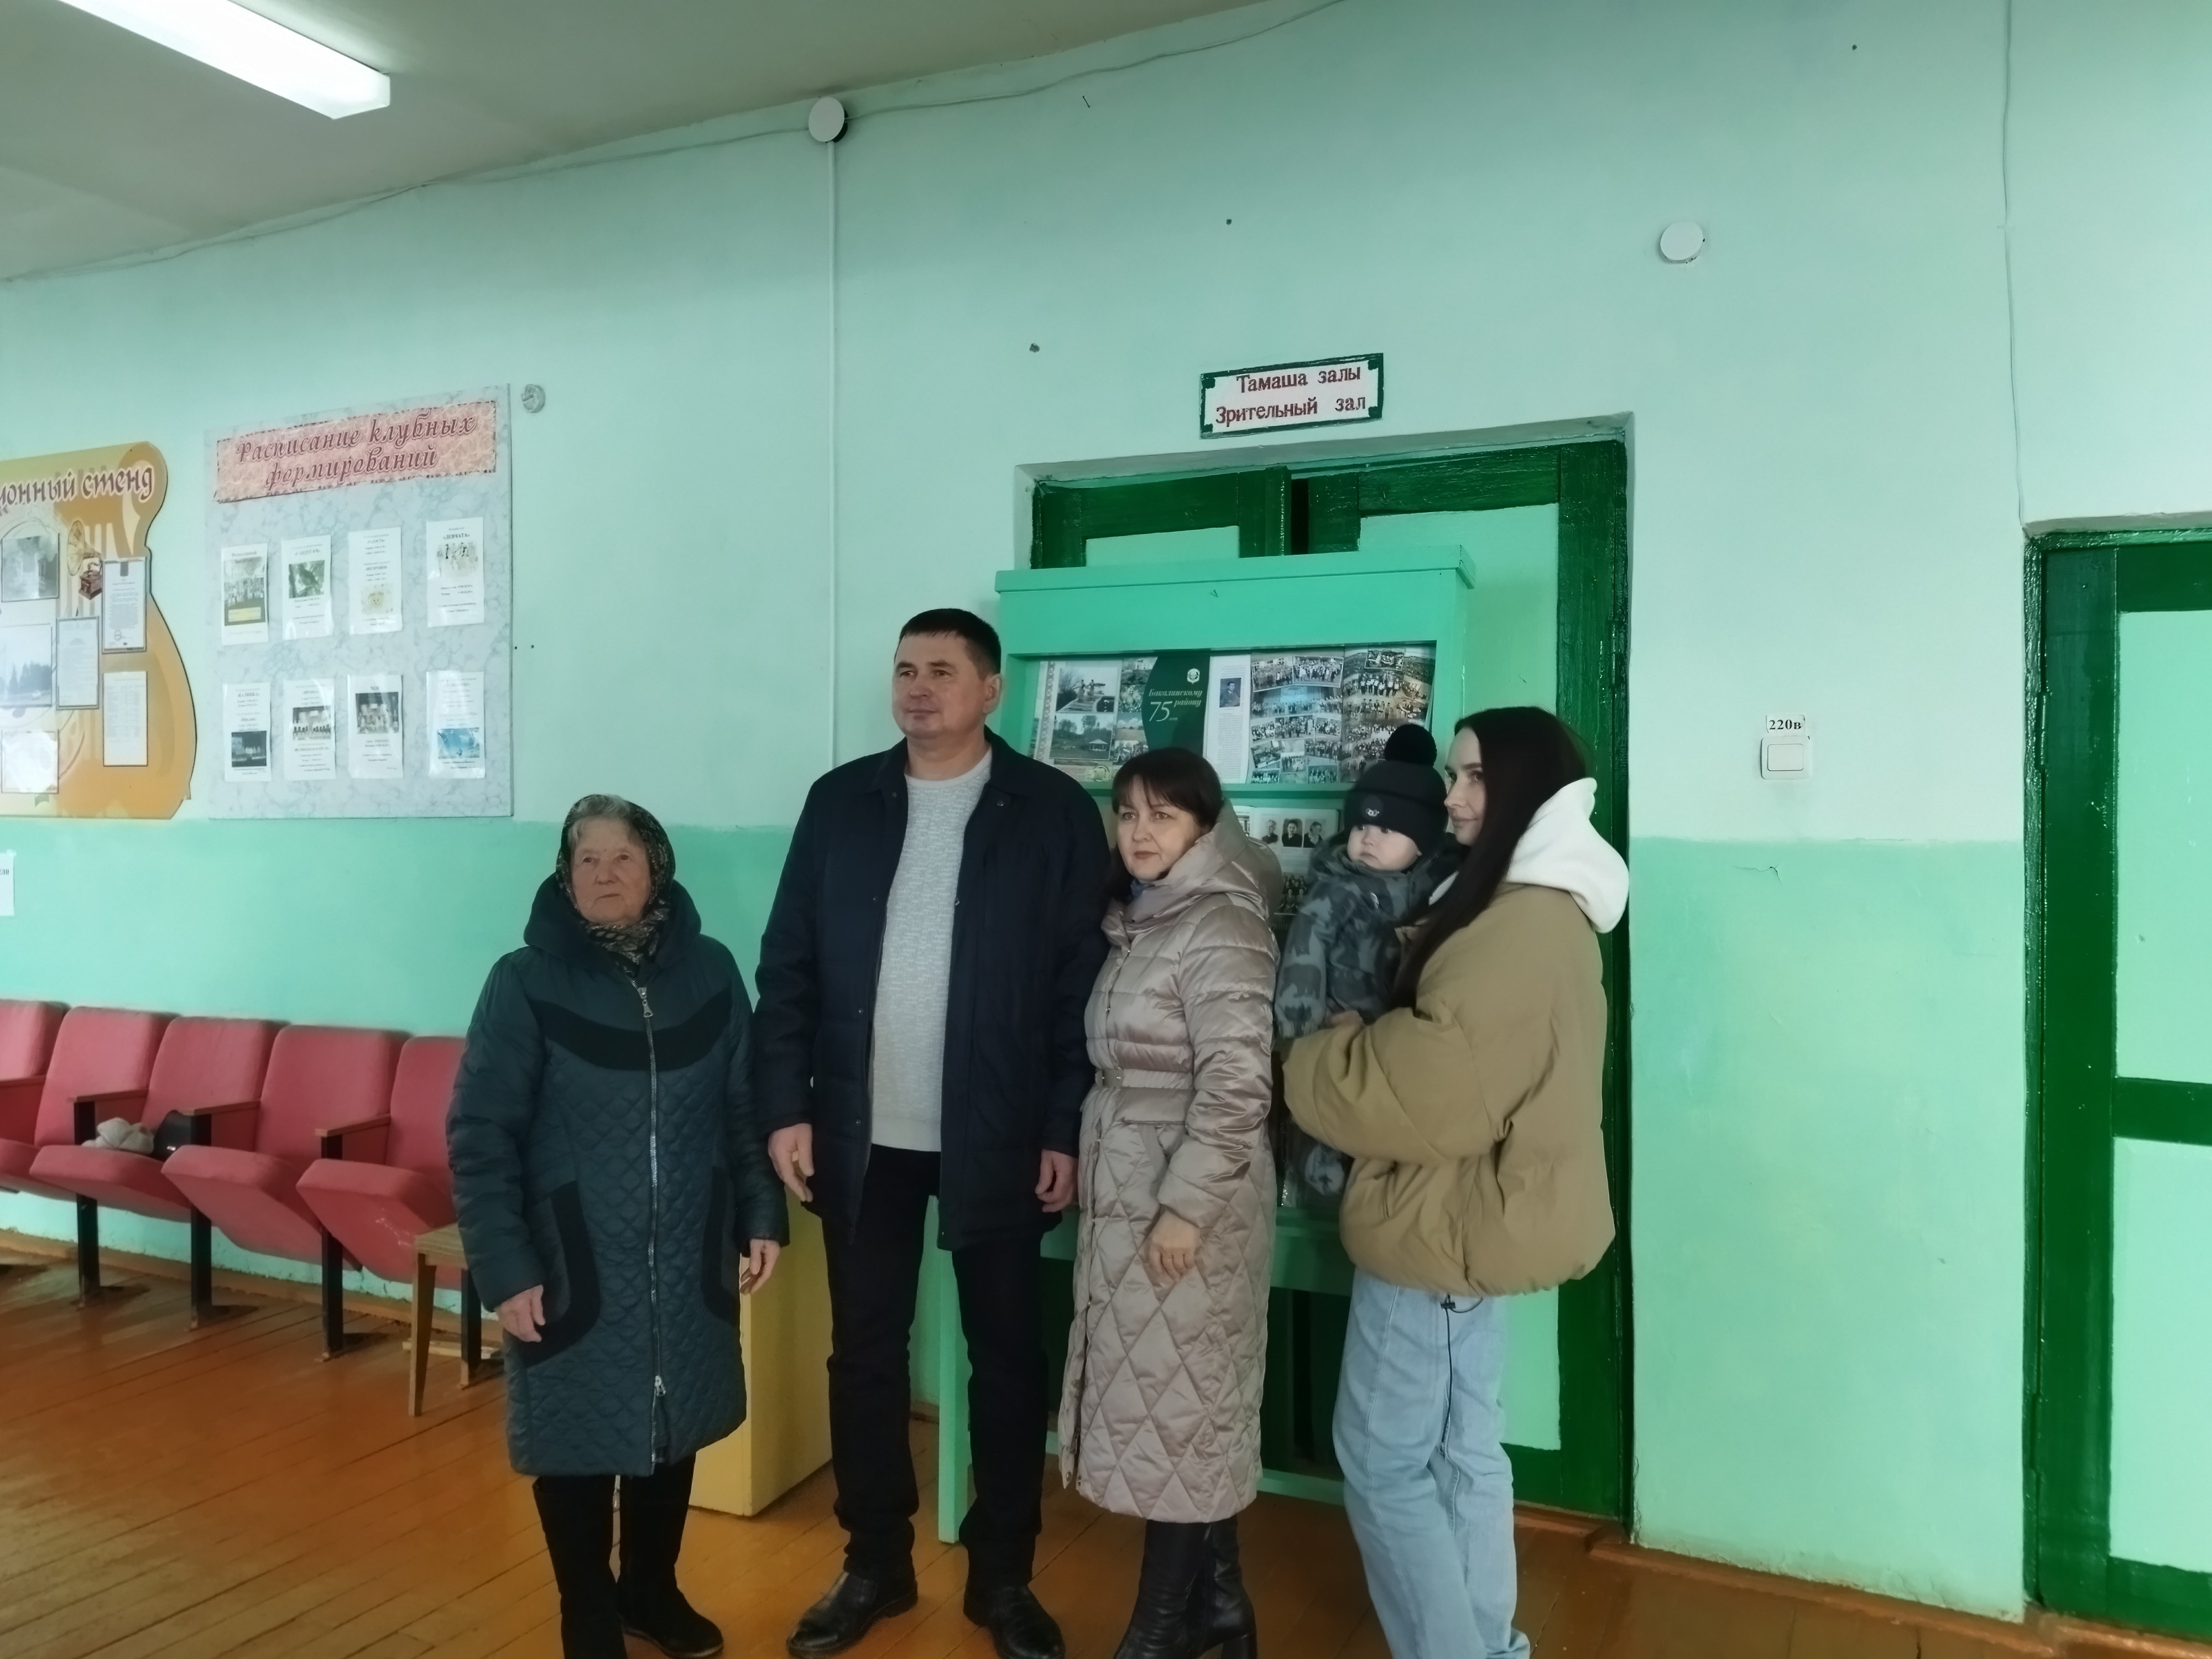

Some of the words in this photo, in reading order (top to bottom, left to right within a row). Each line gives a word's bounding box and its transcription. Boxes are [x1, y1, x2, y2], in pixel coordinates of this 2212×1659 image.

[1236, 373, 1308, 393] Тамаша
[1318, 367, 1361, 384] залы
[1215, 396, 1318, 427] Зрительный
[1334, 397, 1365, 411] зал
[236, 429, 362, 464] Расписание
[369, 409, 477, 448] клубных
[264, 444, 439, 491] формирований
[83, 467, 153, 501] стенд
[1148, 688, 1203, 698] Бакалинскому
[1173, 698, 1202, 708] району
[1149, 701, 1173, 722] 75
